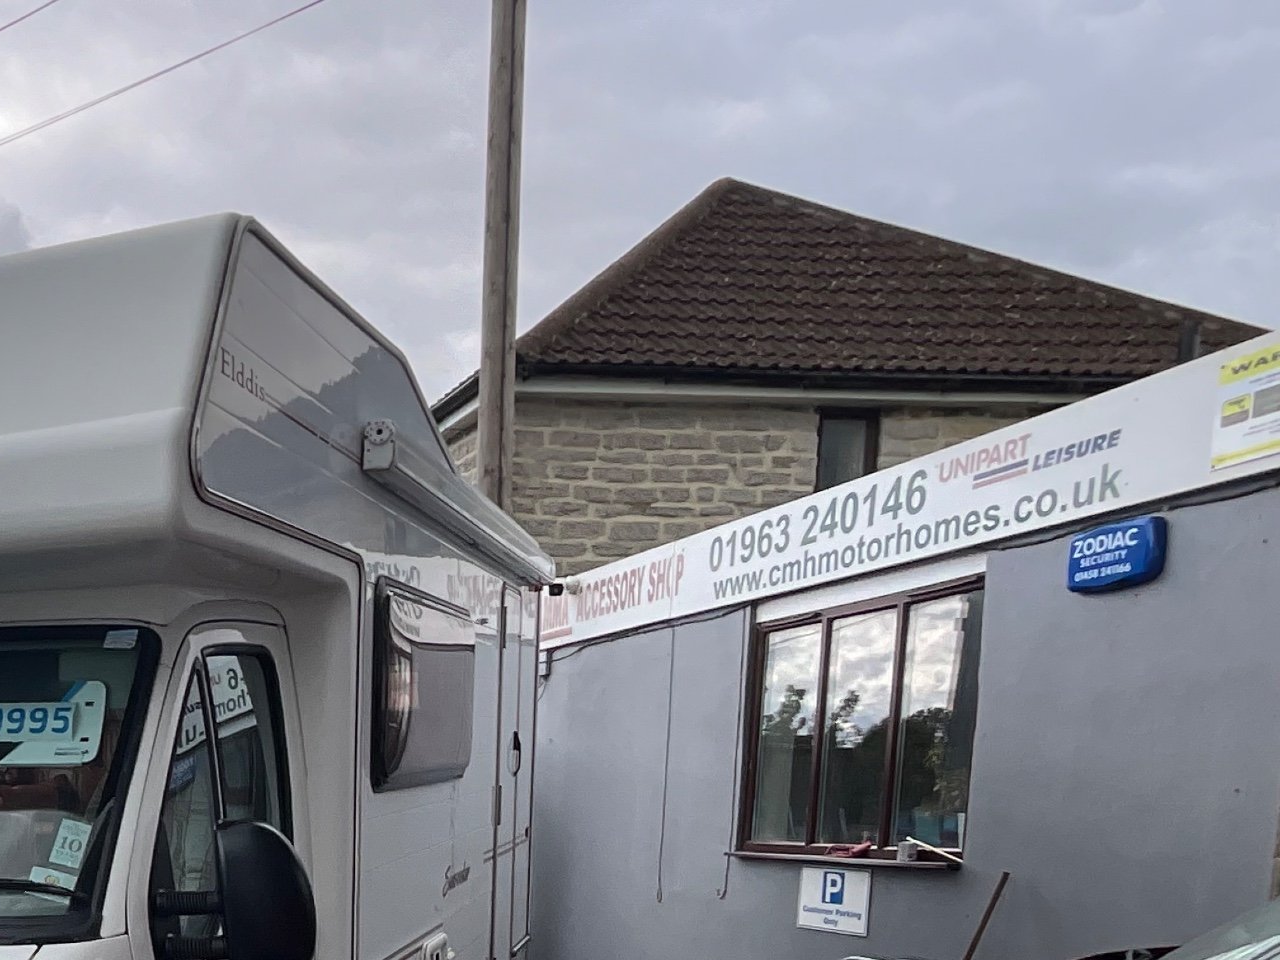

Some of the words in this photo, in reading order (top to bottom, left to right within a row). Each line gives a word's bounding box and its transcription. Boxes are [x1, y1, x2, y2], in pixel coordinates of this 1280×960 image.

[221, 346, 265, 401] Elddis
[938, 433, 1032, 483] UNIPART
[1032, 429, 1122, 472] LEISURE
[709, 514, 791, 572] 01963
[800, 469, 928, 546] 240146
[713, 463, 1123, 600] www.cmhmotorhomes.co.uk
[1072, 528, 1139, 558] ZODIAC
[1080, 549, 1128, 568] SECURITY
[576, 565, 646, 622] ACCESSORY
[825, 872, 842, 902] P
